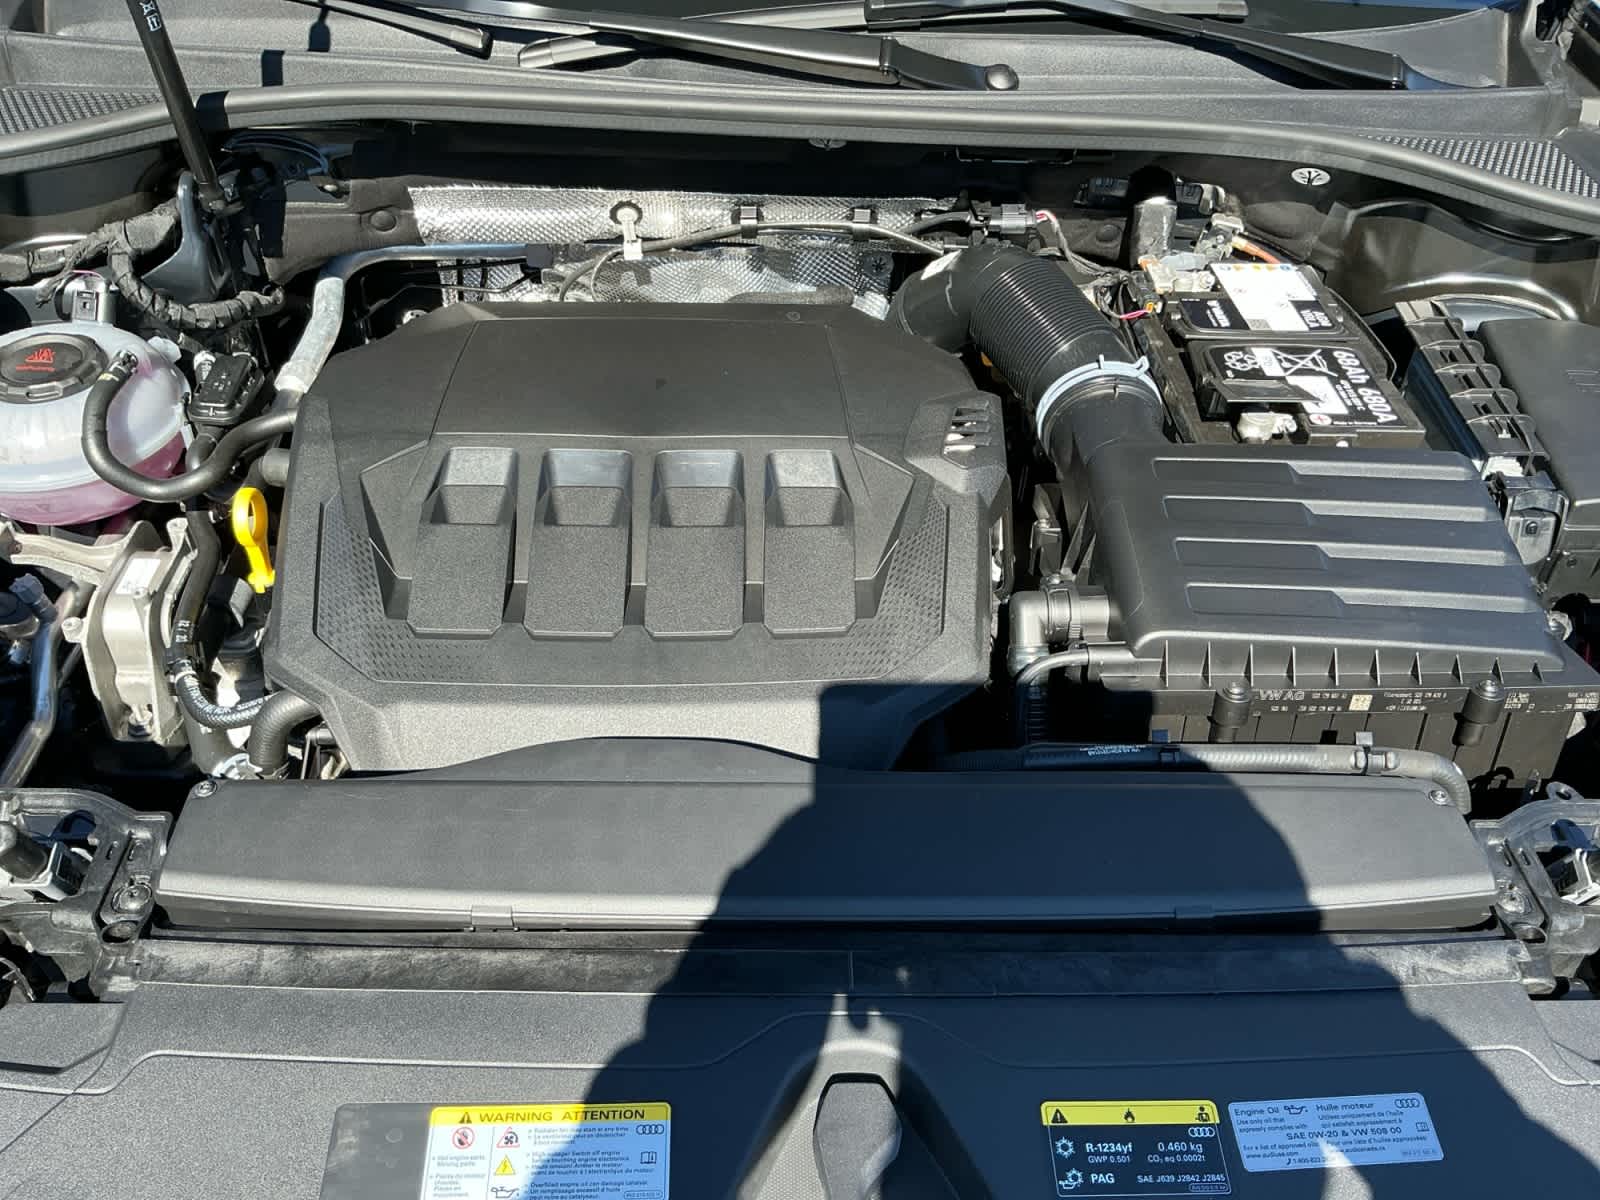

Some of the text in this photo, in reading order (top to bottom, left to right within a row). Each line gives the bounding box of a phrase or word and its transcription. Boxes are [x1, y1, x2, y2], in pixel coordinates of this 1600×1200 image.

[1333, 350, 1370, 384] 68Ah
[1358, 387, 1398, 423] 680A
[1234, 1106, 1280, 1117] Engine Oil
[1315, 1103, 1375, 1112] Huile moteur
[479, 1109, 646, 1123] WARNING ATTENTION
[1286, 1126, 1402, 1140] SAE 0W-20 & VW 508 00
[1085, 1141, 1204, 1154] R-1234yf 0.460 kg
[1087, 1155, 1108, 1164] GWP
[1109, 1155, 1131, 1163] 0.501
[1090, 1173, 1115, 1184] PAG
[1136, 1174, 1154, 1183] SAE
[1177, 1173, 1201, 1182] J2842
[1202, 1173, 1226, 1182] J2845
